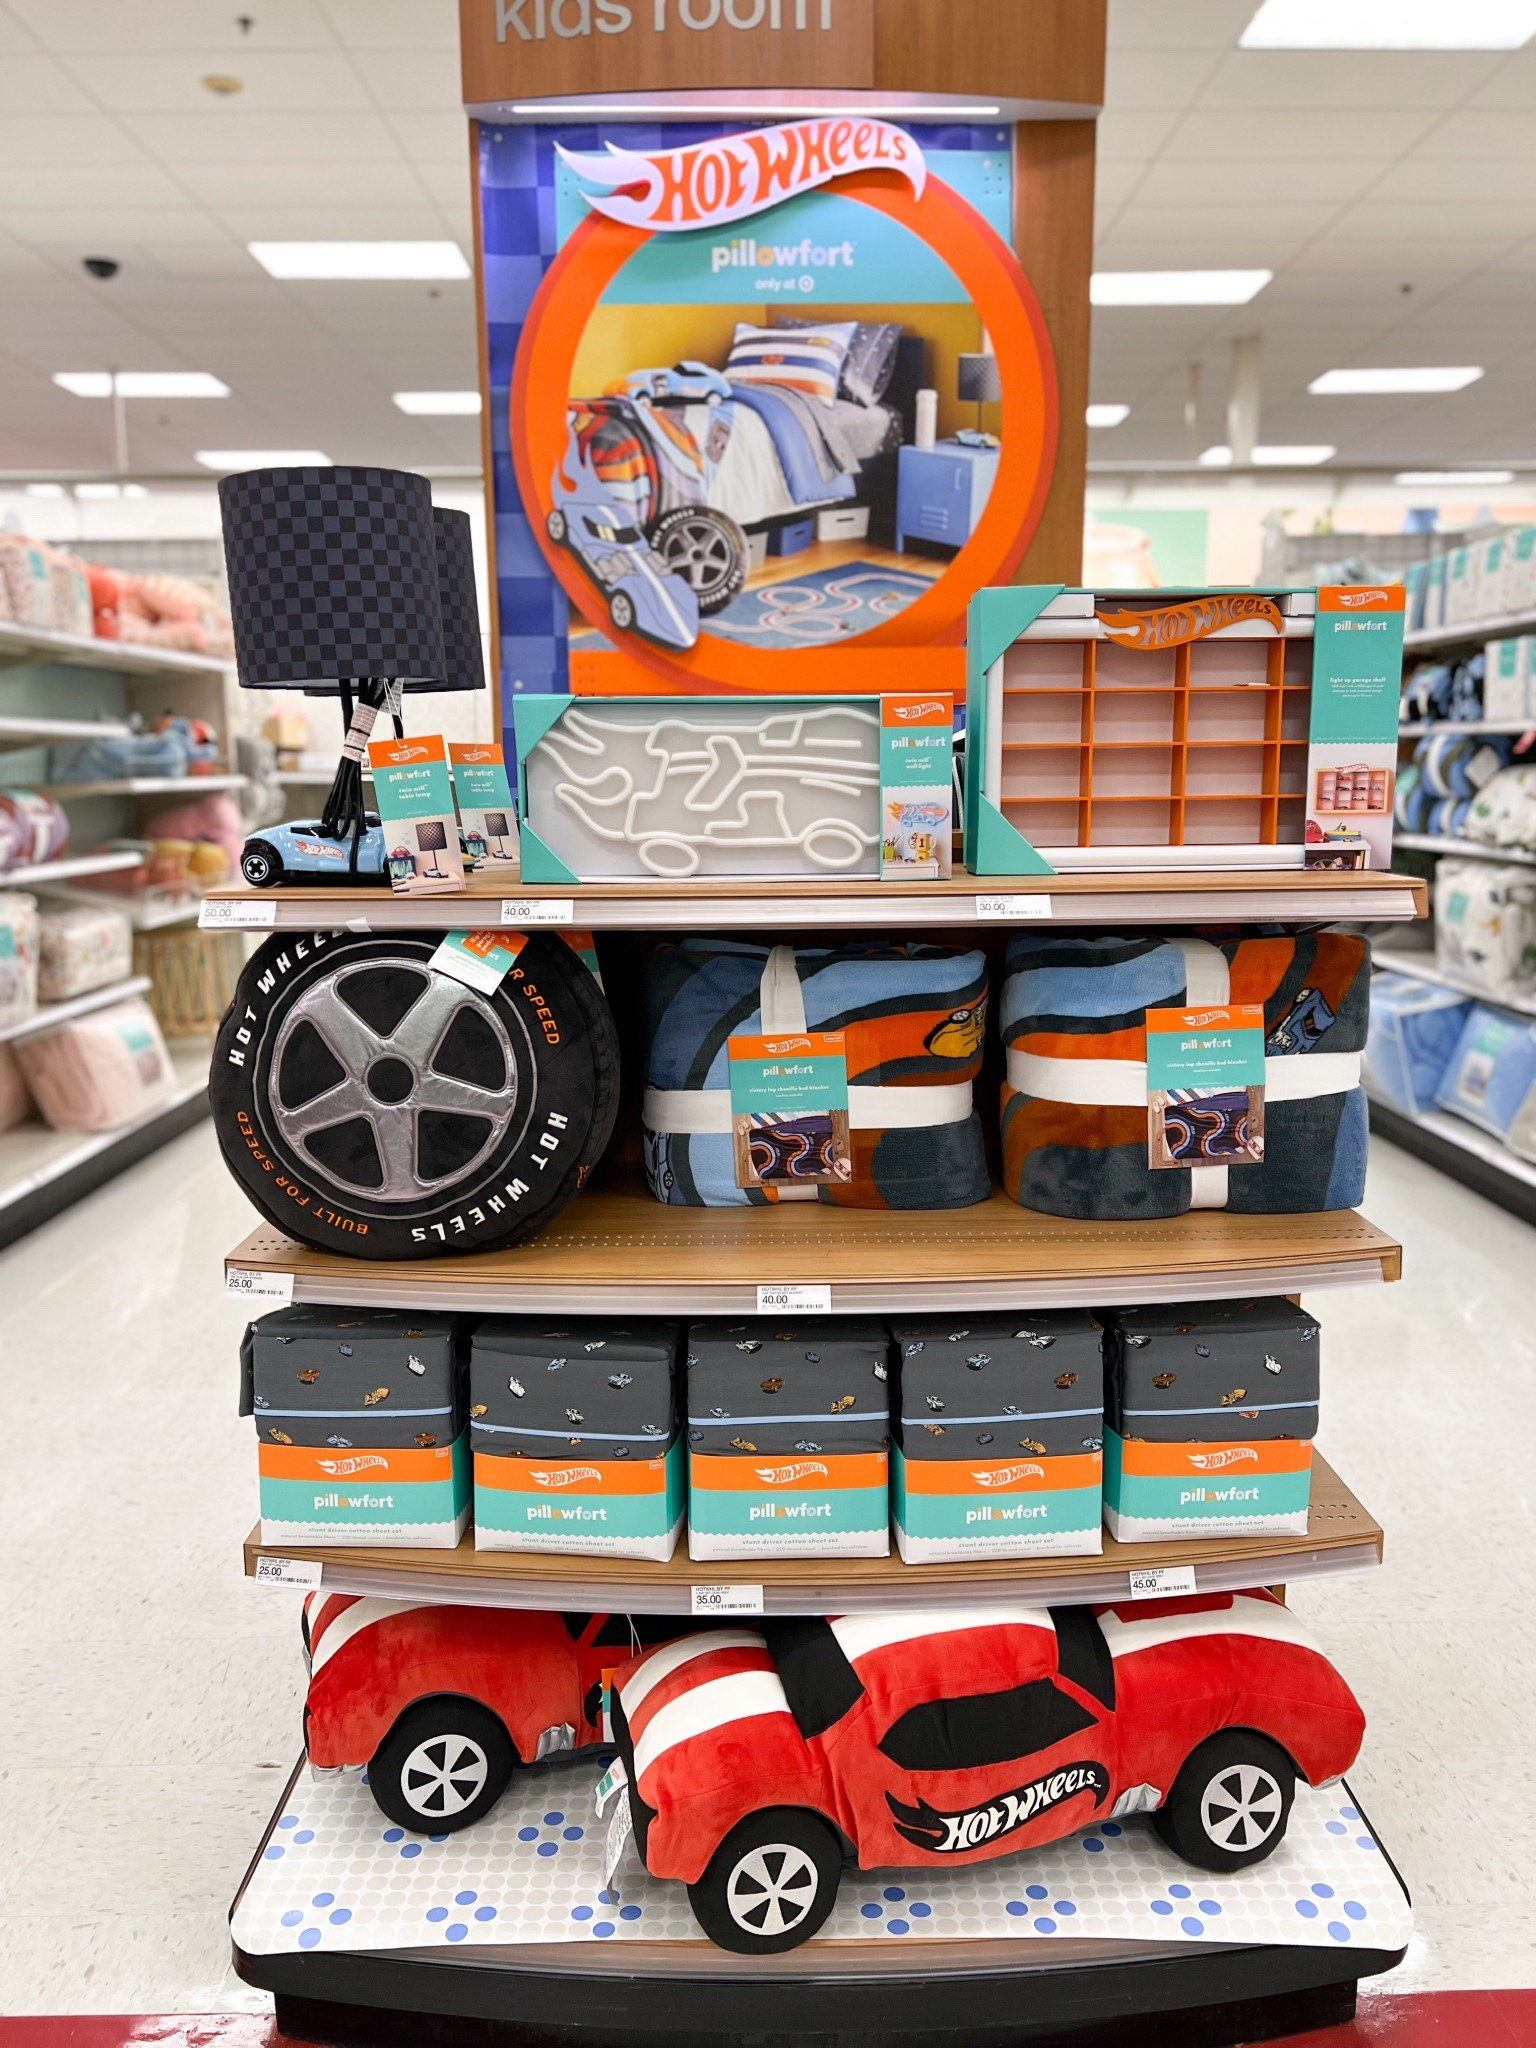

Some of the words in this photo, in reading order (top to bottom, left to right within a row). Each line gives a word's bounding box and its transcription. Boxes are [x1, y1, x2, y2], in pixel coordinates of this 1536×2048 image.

[496, 0, 633, 43] kids
[654, 0, 832, 31] room
[711, 239, 854, 272] pillowfort
[755, 278, 782, 291] only
[783, 279, 797, 290] at
[1334, 620, 1387, 632] pillowfort
[891, 736, 946, 750] pillowfort
[389, 769, 431, 782] pillowfort
[463, 769, 494, 777] pillowfort
[204, 908, 232, 917] 50.00
[504, 907, 530, 916] 40.00
[979, 903, 1005, 911] 30.00
[228, 1005, 257, 1067] HOT
[257, 931, 344, 995] WHEE
[523, 984, 560, 1044] SPEED
[1181, 1038, 1232, 1051] pillowfort
[762, 1064, 813, 1077] pillowfort
[237, 1111, 275, 1172] SPEED
[530, 1112, 569, 1171] HOT
[275, 1176, 310, 1207] FOR
[411, 1178, 530, 1242] WHEELS
[312, 1207, 369, 1235] BUILT
[229, 1279, 252, 1288] 25.00
[762, 1295, 788, 1304] 40.00
[314, 1493, 394, 1510] pillowfort
[1180, 1487, 1260, 1505] pillowfort
[527, 1504, 607, 1521] pillowfort
[750, 1503, 832, 1520] pillowfort
[966, 1504, 1048, 1524] pillowfort
[258, 1566, 282, 1576] 25.00
[1133, 1578, 1157, 1588] 45.00
[696, 1595, 721, 1604] 35.00
